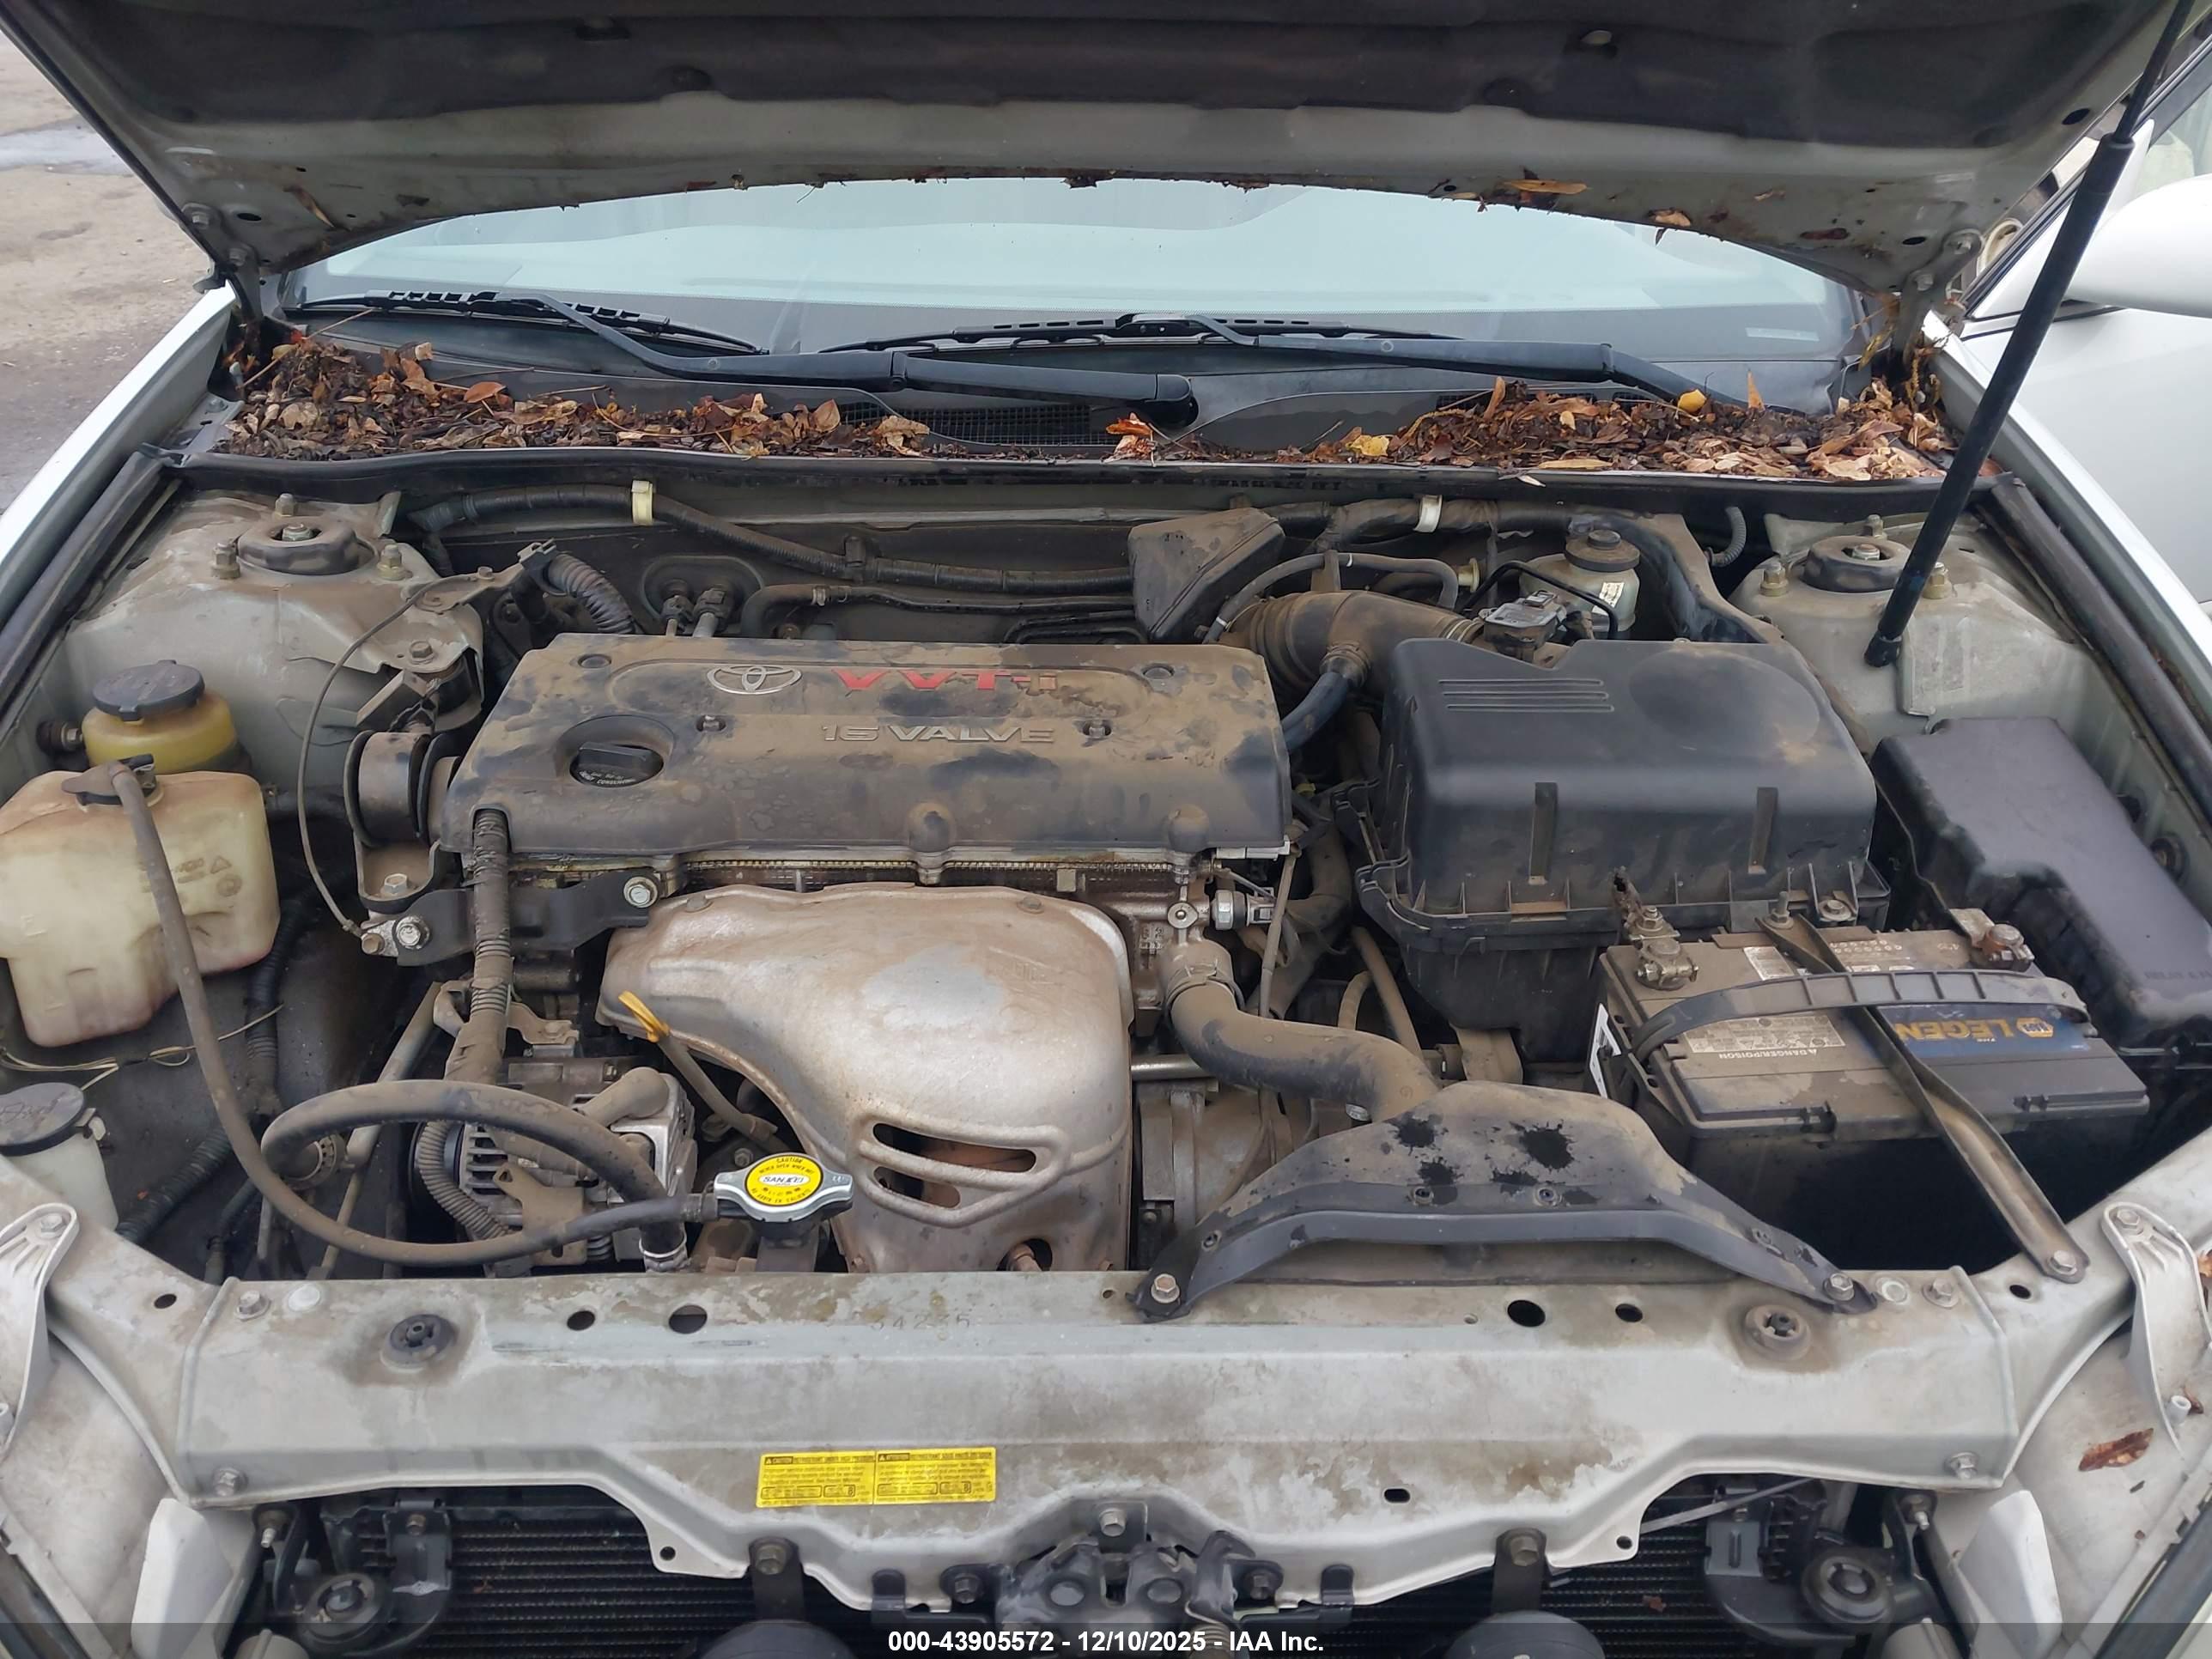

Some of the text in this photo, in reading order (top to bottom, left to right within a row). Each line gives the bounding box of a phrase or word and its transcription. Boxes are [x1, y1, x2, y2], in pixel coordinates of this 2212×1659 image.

[822, 725, 1054, 742] 16 VALVE
[1894, 1018, 2014, 1040] LEGEN
